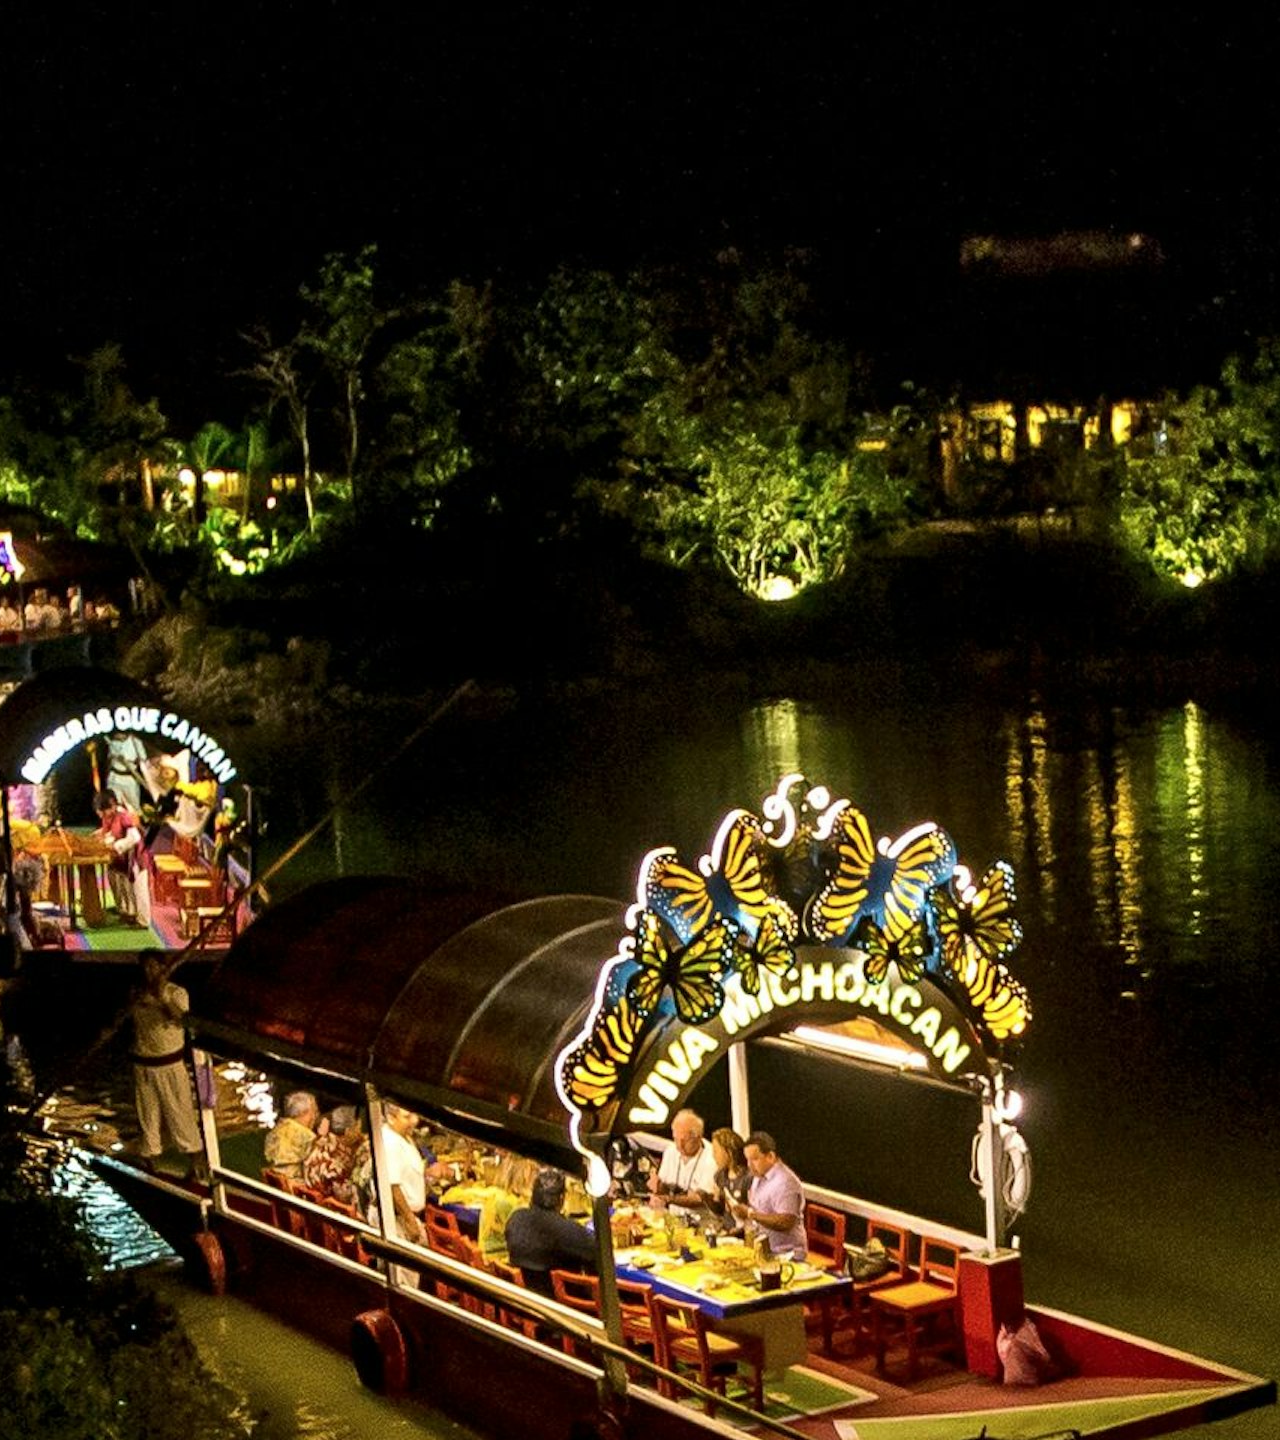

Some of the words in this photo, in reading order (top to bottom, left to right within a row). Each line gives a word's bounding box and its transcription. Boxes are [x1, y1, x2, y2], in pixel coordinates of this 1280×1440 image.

[115, 707, 159, 732] QUE
[161, 714, 236, 783] CANTAN
[628, 1027, 719, 1125] VIVA
[719, 962, 971, 1073] MICHOACAN
